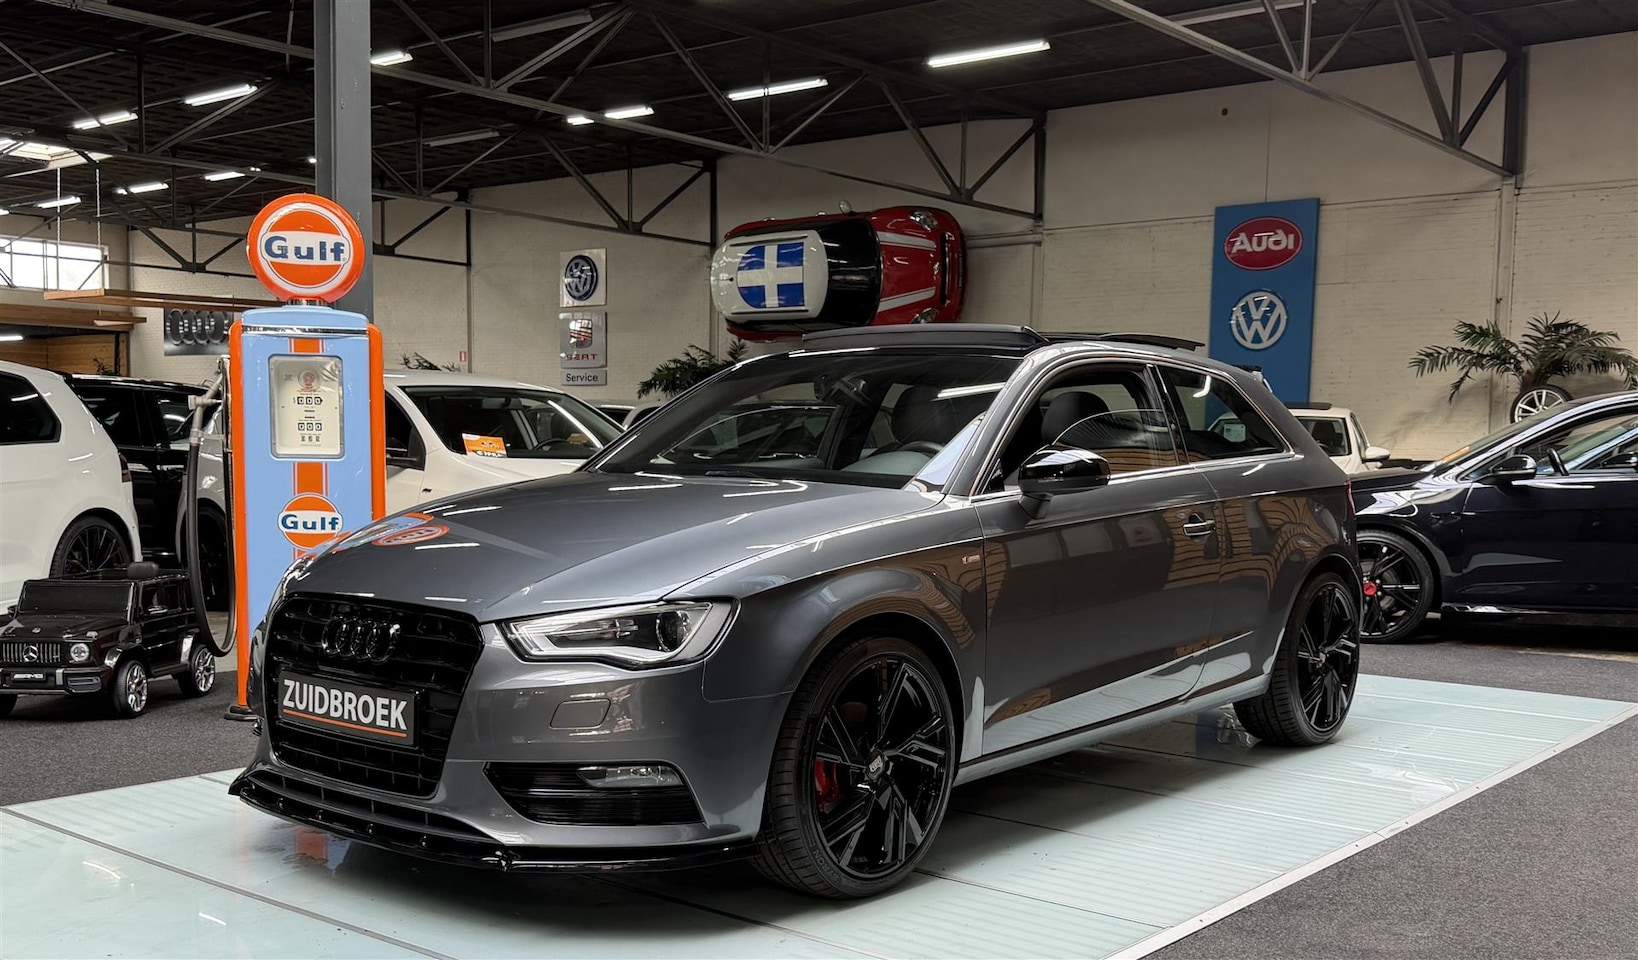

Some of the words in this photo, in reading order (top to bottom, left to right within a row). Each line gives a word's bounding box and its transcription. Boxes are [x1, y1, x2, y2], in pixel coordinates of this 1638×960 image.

[265, 235, 345, 262] Gulf
[566, 373, 599, 383] Service
[282, 513, 339, 530] Gulf
[282, 679, 407, 730] ZUIDBROEK
